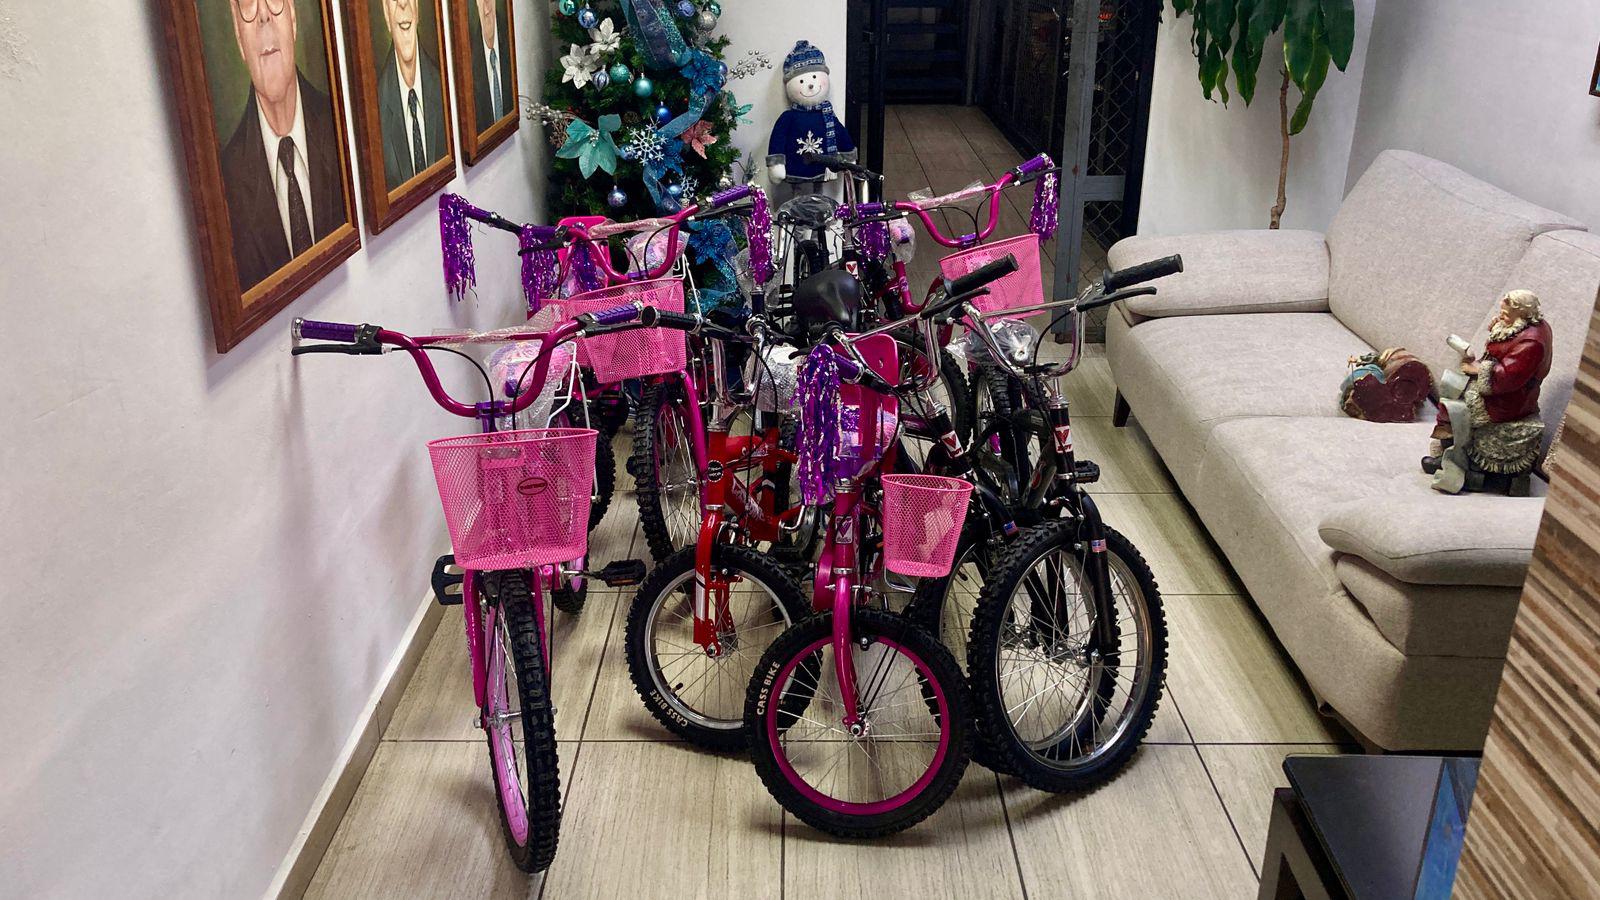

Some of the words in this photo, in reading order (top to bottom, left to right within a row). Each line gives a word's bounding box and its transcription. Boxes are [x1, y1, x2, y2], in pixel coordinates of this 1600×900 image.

[757, 687, 769, 715] CASS
[764, 661, 780, 685] BIKE
[650, 689, 668, 710] BIKE
[666, 708, 688, 727] CASS
